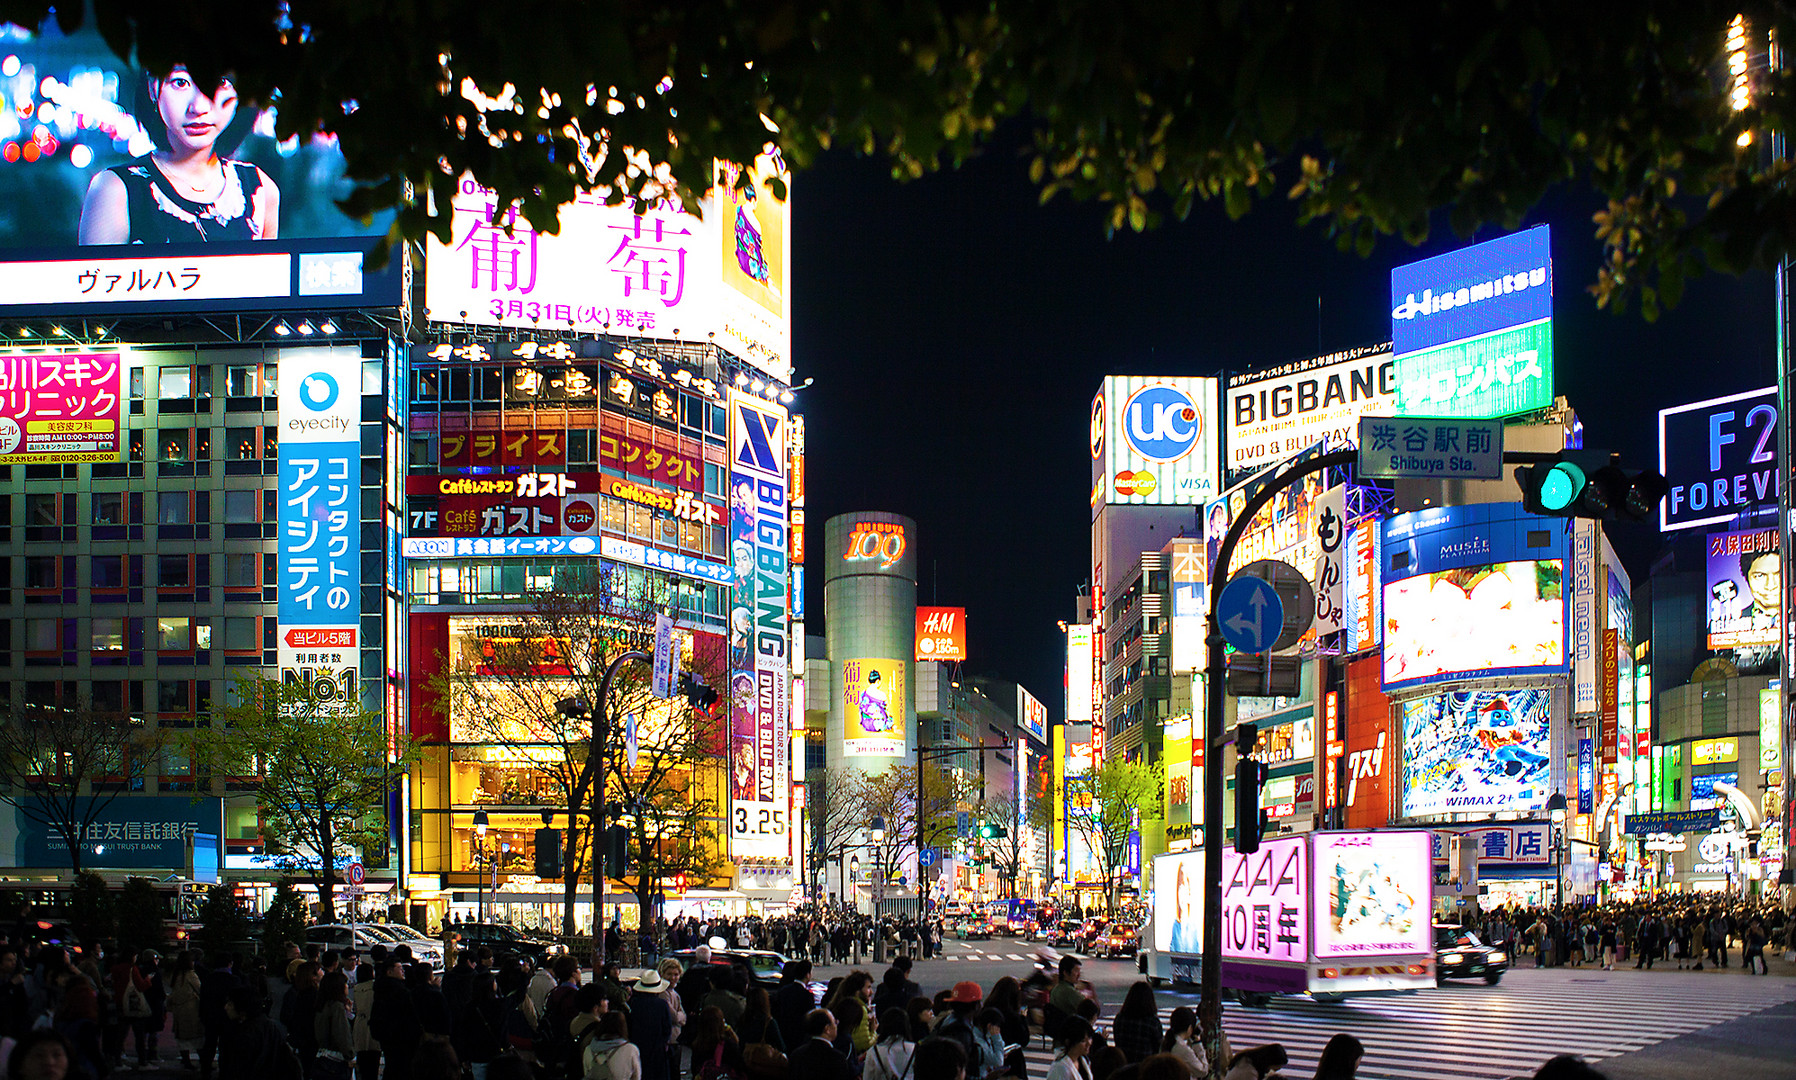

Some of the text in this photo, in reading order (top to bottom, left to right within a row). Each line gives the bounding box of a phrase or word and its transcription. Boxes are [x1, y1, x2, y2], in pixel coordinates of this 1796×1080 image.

[78, 267, 201, 293] ヴァルハラ
[1392, 267, 1546, 320] Hisamitsu
[489, 299, 656, 330] 3月31日(火)発売
[0, 357, 117, 390] 川スキン
[1401, 349, 1543, 409] サロンパス
[0, 388, 116, 419] リニック
[1235, 362, 1394, 427] BIGBANG
[289, 417, 350, 433] eyecity
[1371, 424, 1492, 454] 渋谷駅前
[443, 434, 562, 459] プライス
[600, 434, 701, 482] コンタクト
[1390, 455, 1477, 473] Shibuya Sta.
[516, 473, 577, 498] ガスト
[1180, 478, 1211, 489] VISA
[1671, 469, 1780, 515] FOREV
[410, 511, 438, 529] 7F
[445, 510, 477, 524] Café
[481, 505, 554, 535] ガスト
[568, 515, 593, 524] ガスト
[674, 490, 720, 526] ガスト
[287, 458, 321, 611] アイシティ
[327, 457, 351, 610] コンタクトの
[446, 524, 477, 533] レストラン
[457, 538, 567, 556] 英会話イーオン
[843, 531, 908, 569] 109
[758, 478, 785, 659] BIGBANG
[1316, 505, 1343, 628] もんじゃ
[1576, 524, 1594, 661] Taisei neon
[293, 631, 351, 645] 当ビル5階
[923, 612, 956, 635] H&M
[296, 653, 341, 663] 利用者数
[281, 666, 358, 703] No.1
[759, 674, 774, 800] DVD & BLU-RAY
[1446, 796, 1494, 807] WiMAX
[1630, 810, 1716, 823] バスケットボールストリート
[735, 808, 785, 835] 3.25
[1225, 846, 1300, 898] AAA
[1224, 902, 1300, 957] 10周年
